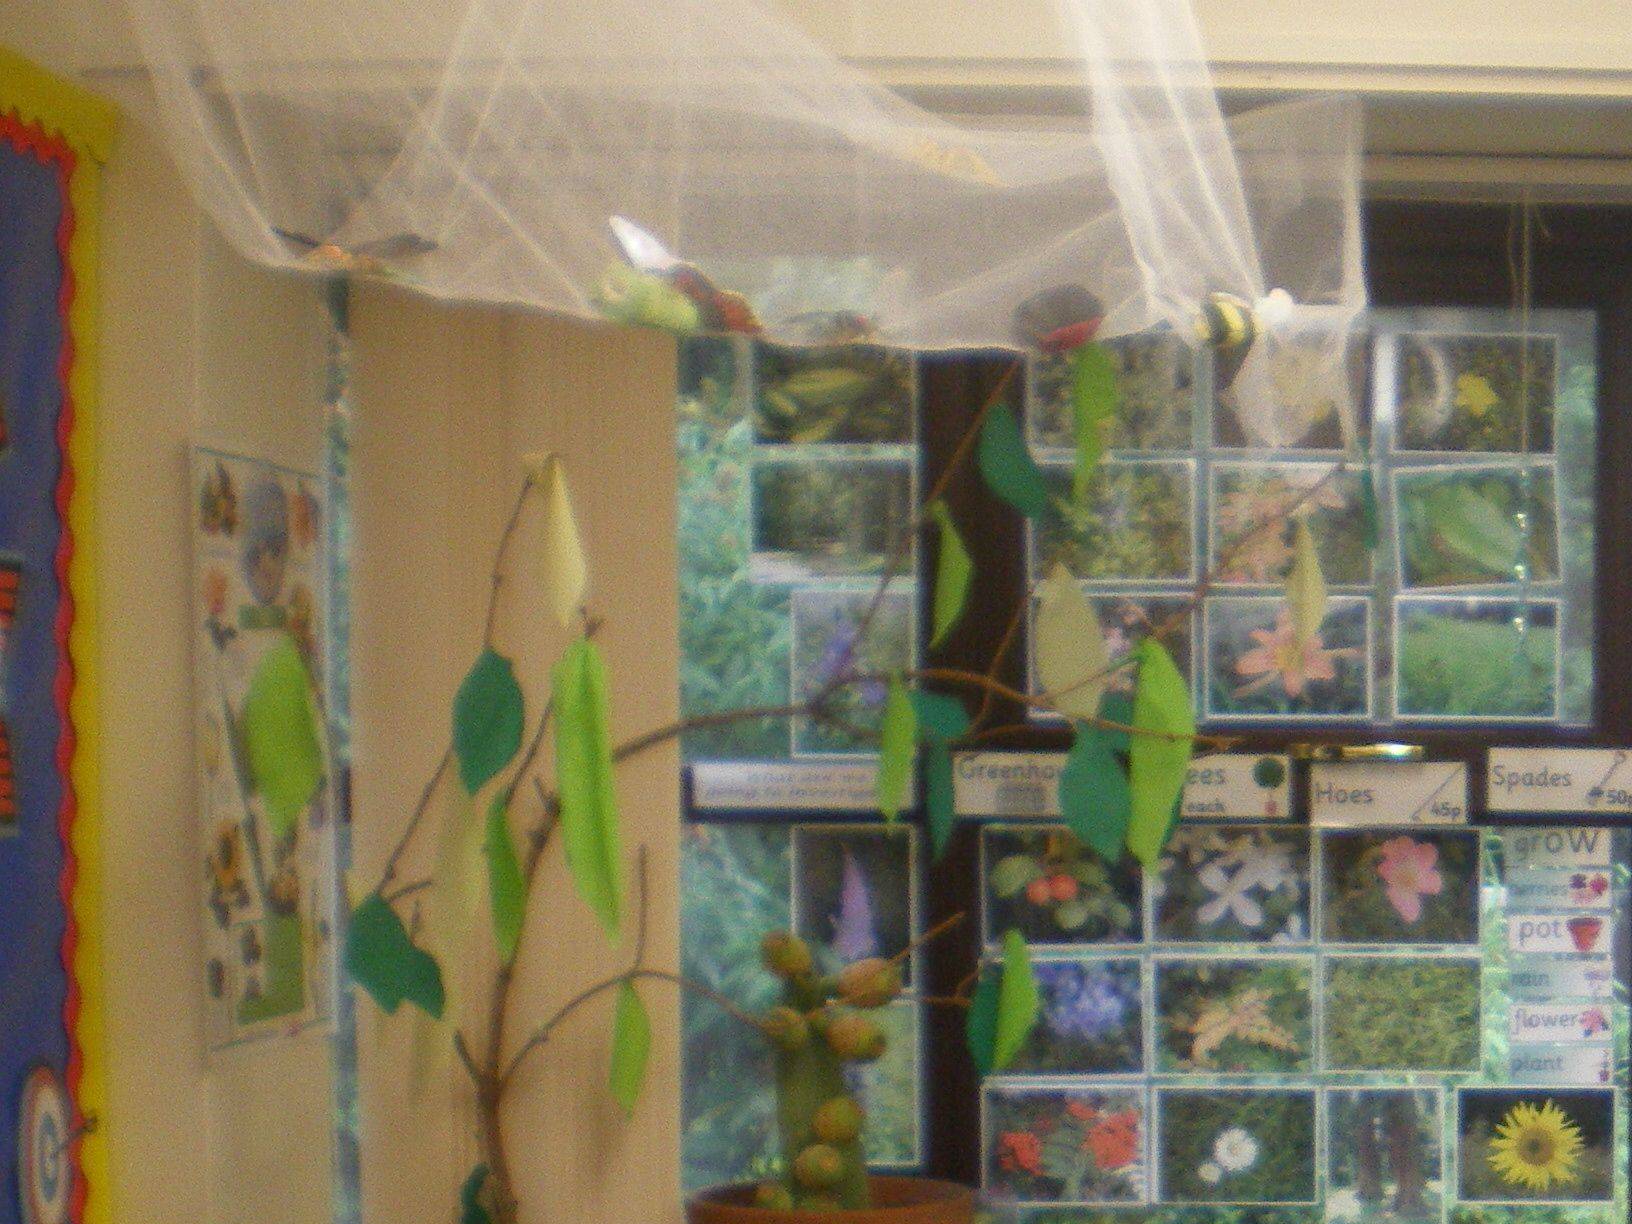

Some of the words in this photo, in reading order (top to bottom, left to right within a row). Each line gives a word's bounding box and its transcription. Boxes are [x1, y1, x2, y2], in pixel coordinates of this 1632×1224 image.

[1312, 782, 1375, 804] Hoes
[1493, 765, 1571, 794] Spades
[1519, 919, 1562, 947] pot
[1513, 1007, 1577, 1035] flower
